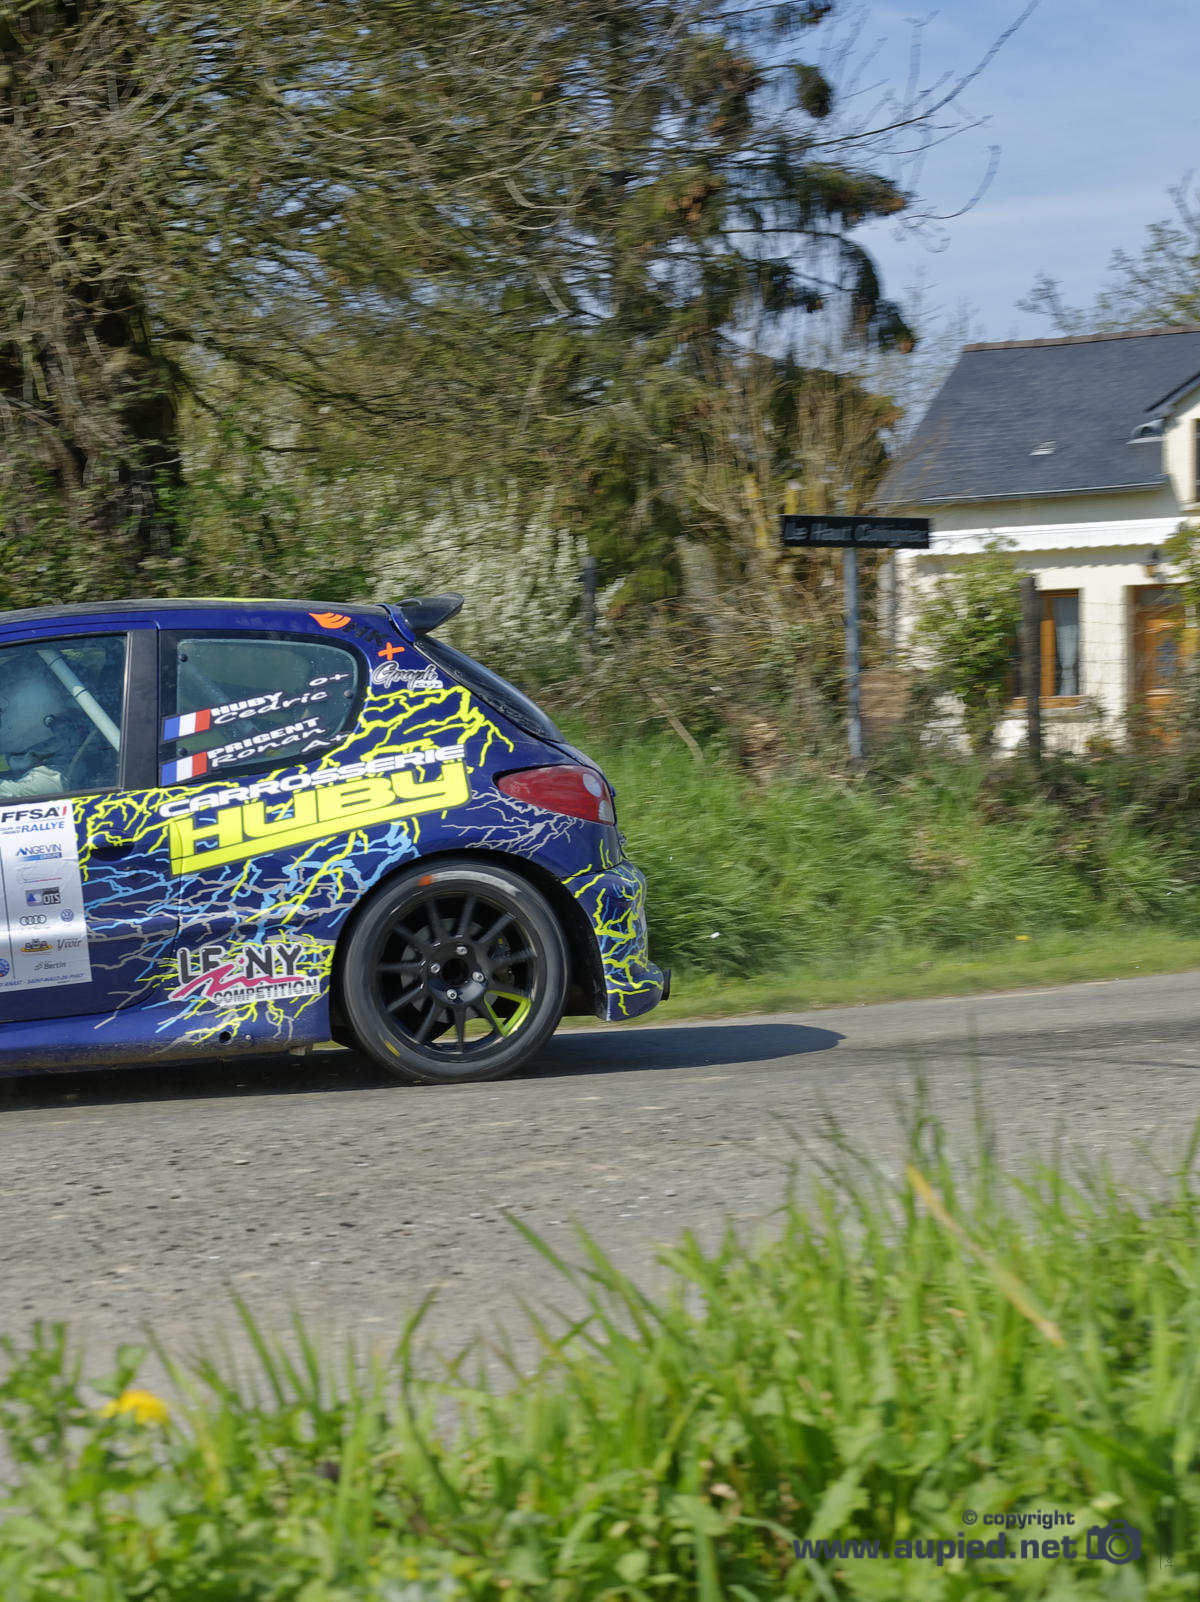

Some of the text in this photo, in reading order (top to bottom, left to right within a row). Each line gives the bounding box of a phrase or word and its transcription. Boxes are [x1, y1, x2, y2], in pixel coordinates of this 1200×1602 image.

[210, 691, 283, 717] HUBY
[207, 716, 319, 760] PRIGENT
[159, 744, 465, 817] CARROSSERIE
[1, 807, 60, 823] FFSA
[21, 821, 65, 833] RALLYE
[170, 762, 469, 875] HUBY
[214, 979, 318, 1005] COMPETITION
